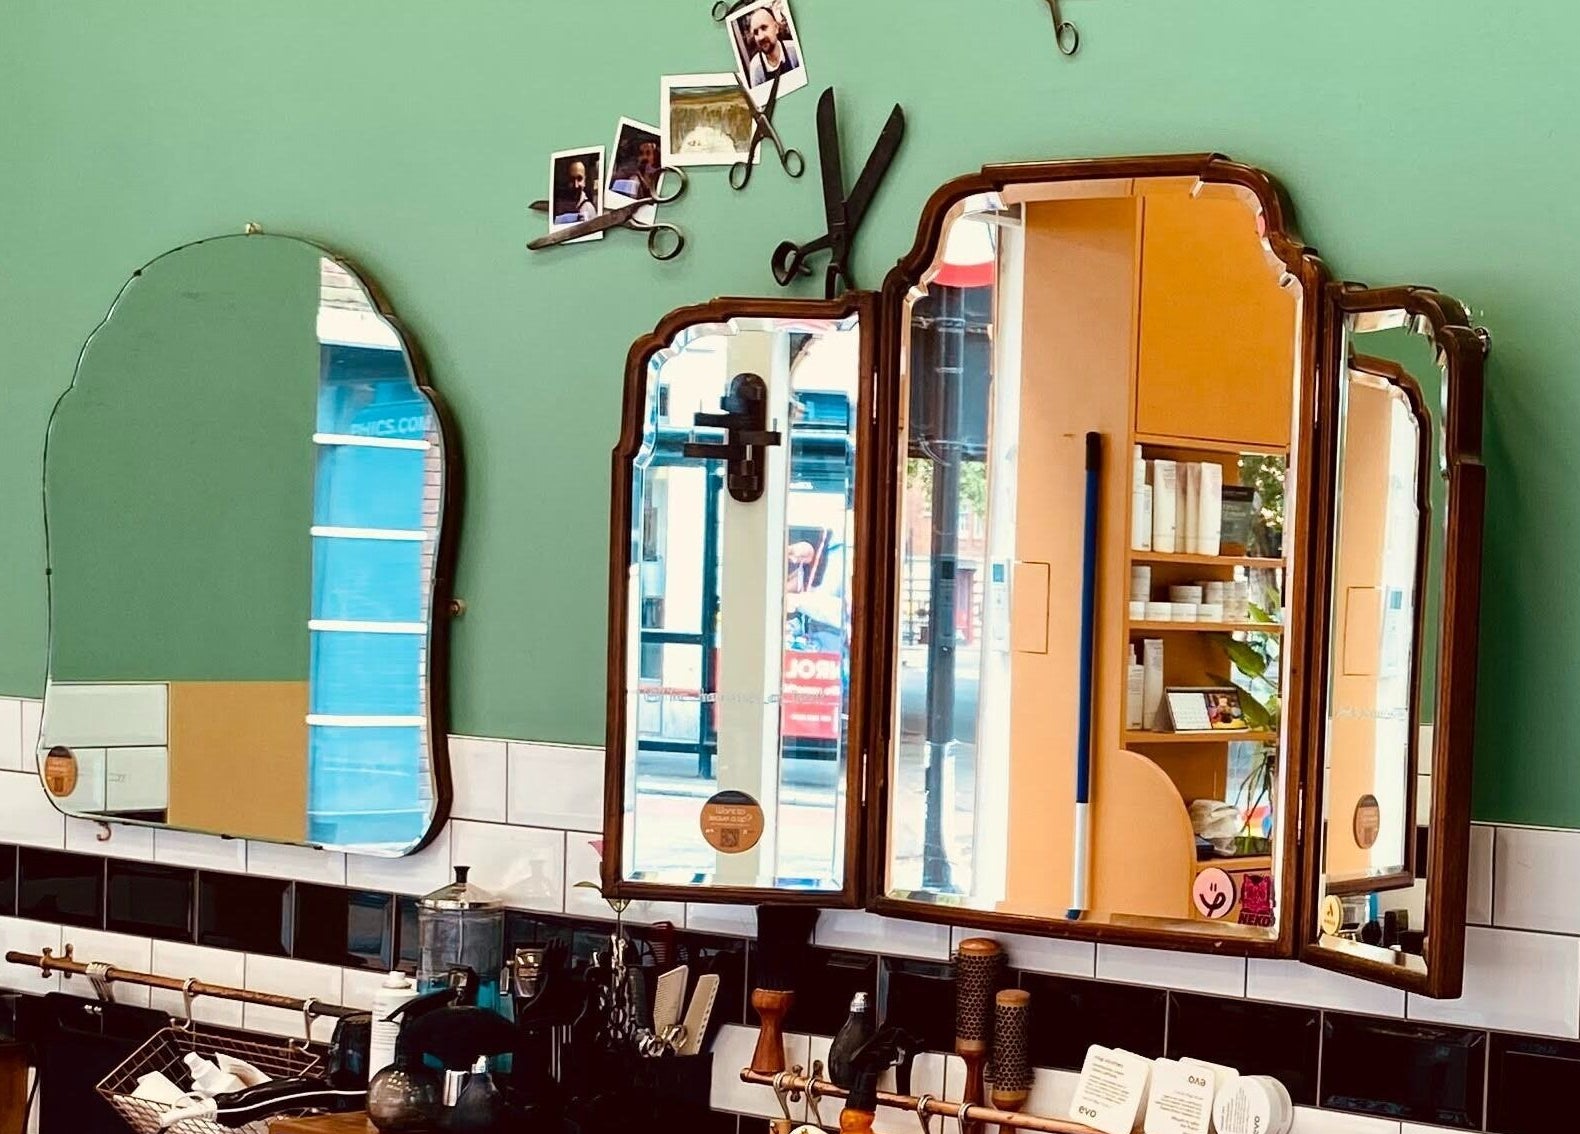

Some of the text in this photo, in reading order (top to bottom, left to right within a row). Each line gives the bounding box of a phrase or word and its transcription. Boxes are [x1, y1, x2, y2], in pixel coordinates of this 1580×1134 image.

[1238, 912, 1272, 927] NEKO
[1188, 1074, 1206, 1087] evo
[1078, 1105, 1097, 1118] evo
